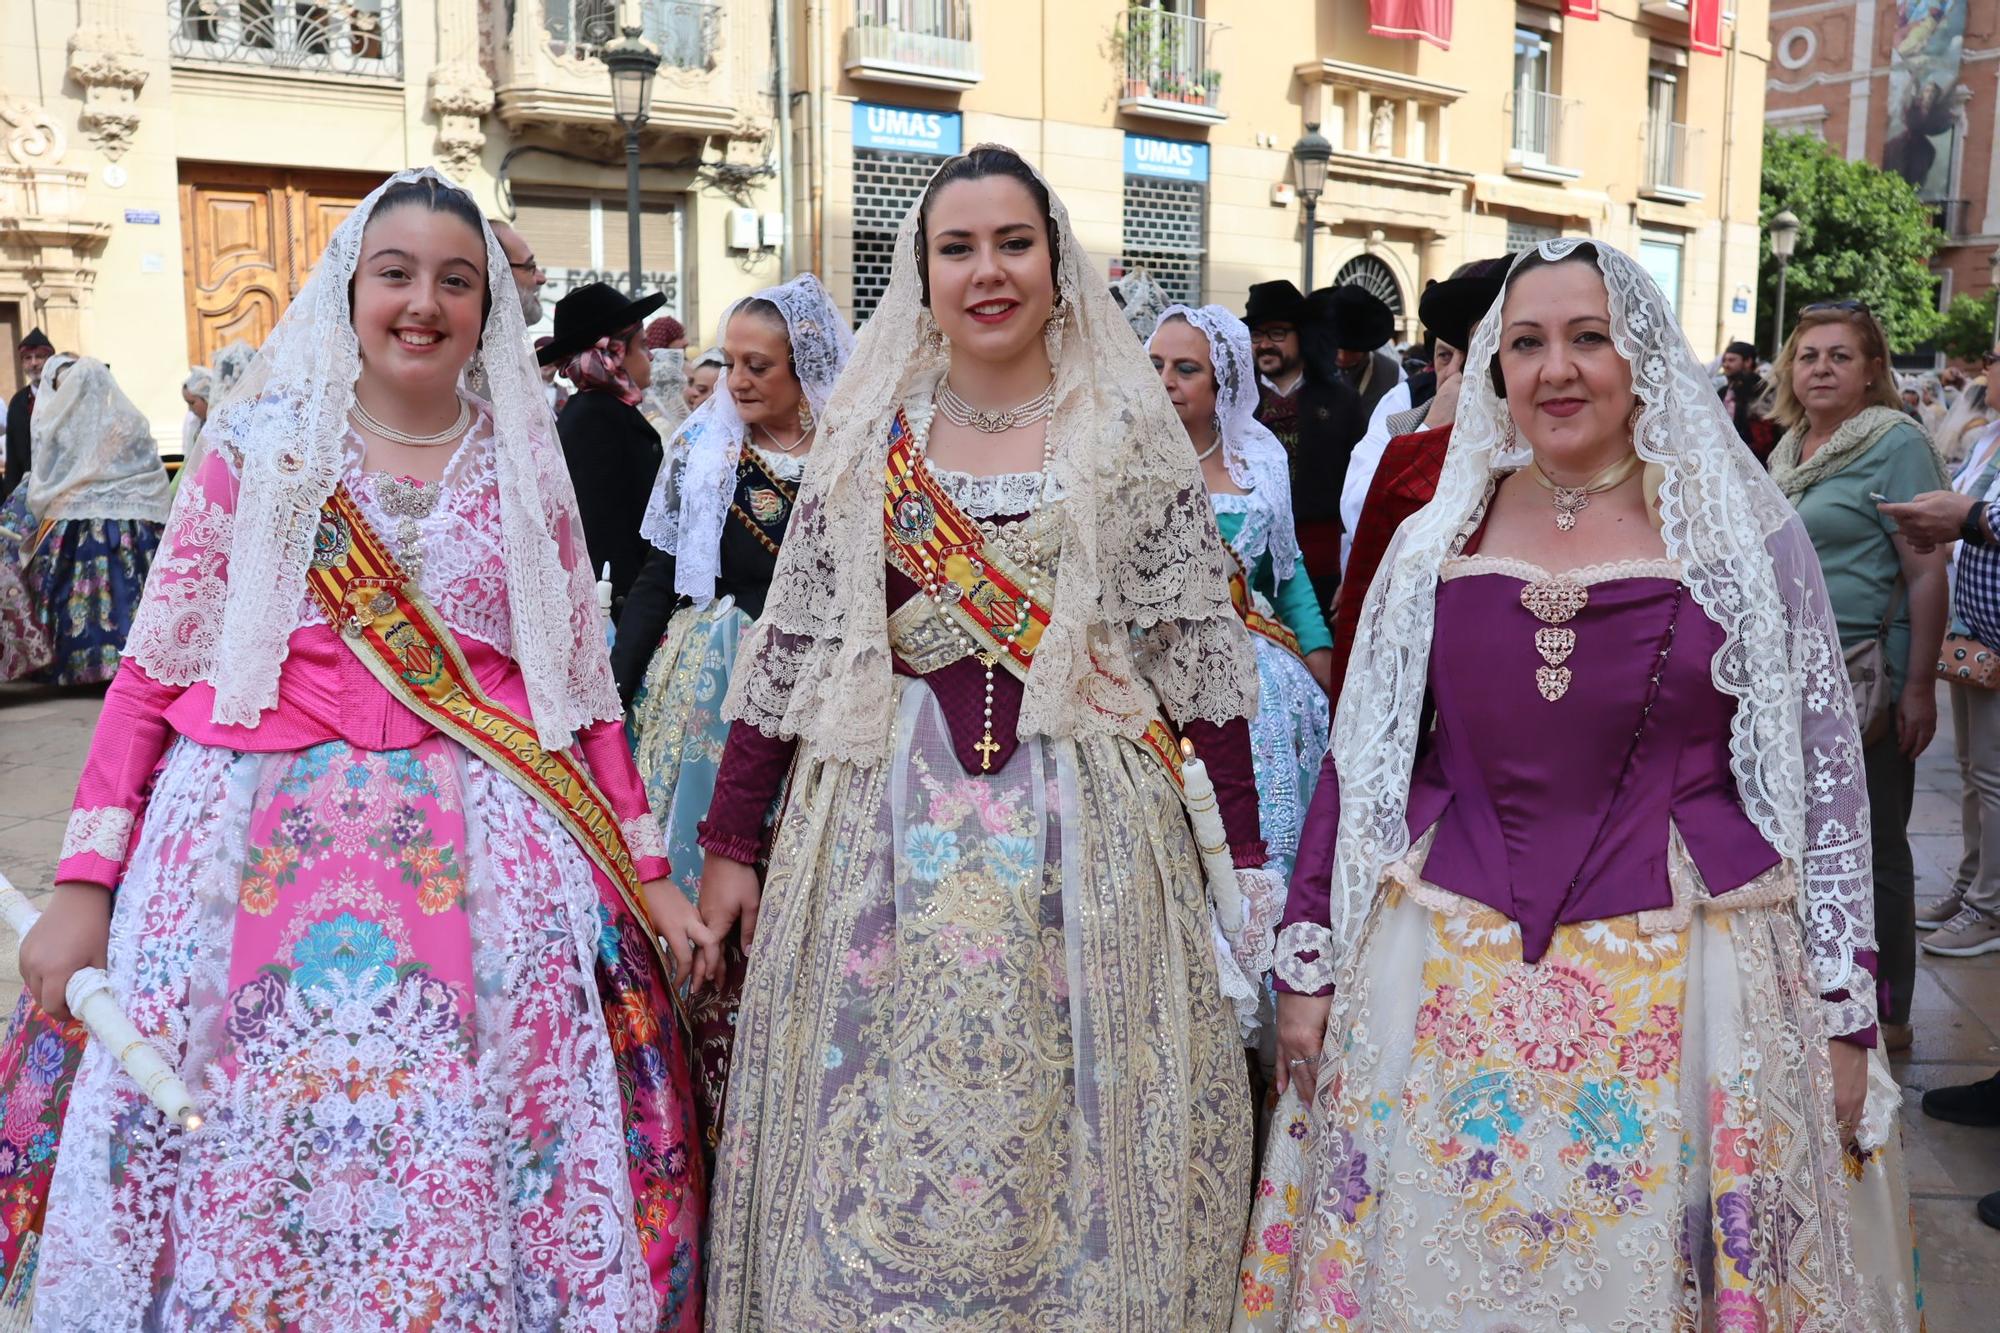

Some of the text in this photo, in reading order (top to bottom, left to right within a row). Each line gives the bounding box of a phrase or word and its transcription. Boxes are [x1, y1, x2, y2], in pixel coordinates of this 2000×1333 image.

[867, 107, 942, 139] UMAS
[1135, 139, 1194, 166] UMAS
[429, 682, 572, 799] FALLERA
[568, 789, 638, 892] MAJOR
